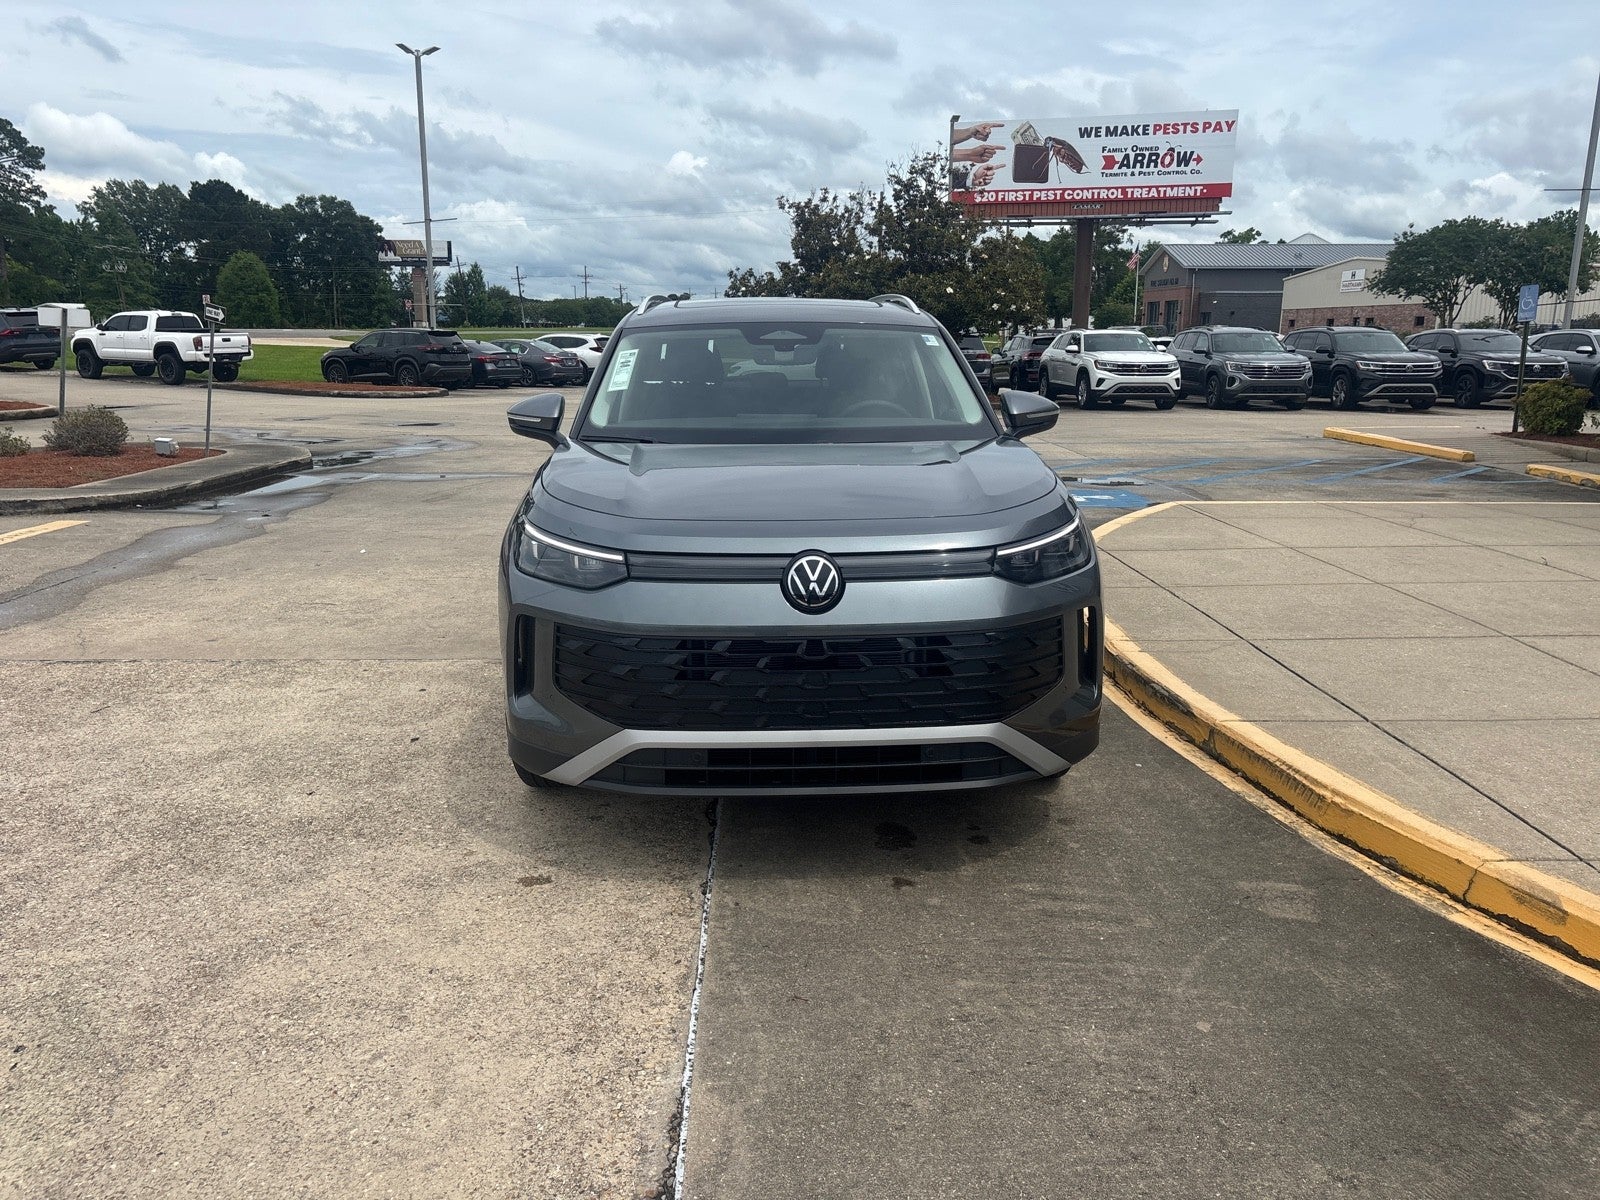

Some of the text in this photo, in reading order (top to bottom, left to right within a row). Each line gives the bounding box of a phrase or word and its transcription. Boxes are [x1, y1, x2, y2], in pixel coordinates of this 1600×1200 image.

[1078, 120, 1236, 139] WE MAKE PESTS PAY
[1101, 145, 1160, 154] FAMILY OWNED
[1118, 150, 1195, 170] ARROW
[974, 192, 996, 203] $20
[998, 190, 1031, 202] FIRST
[1033, 189, 1062, 201] PEST
[1064, 187, 1124, 200] CONTROL
[396, 240, 414, 249] Need
